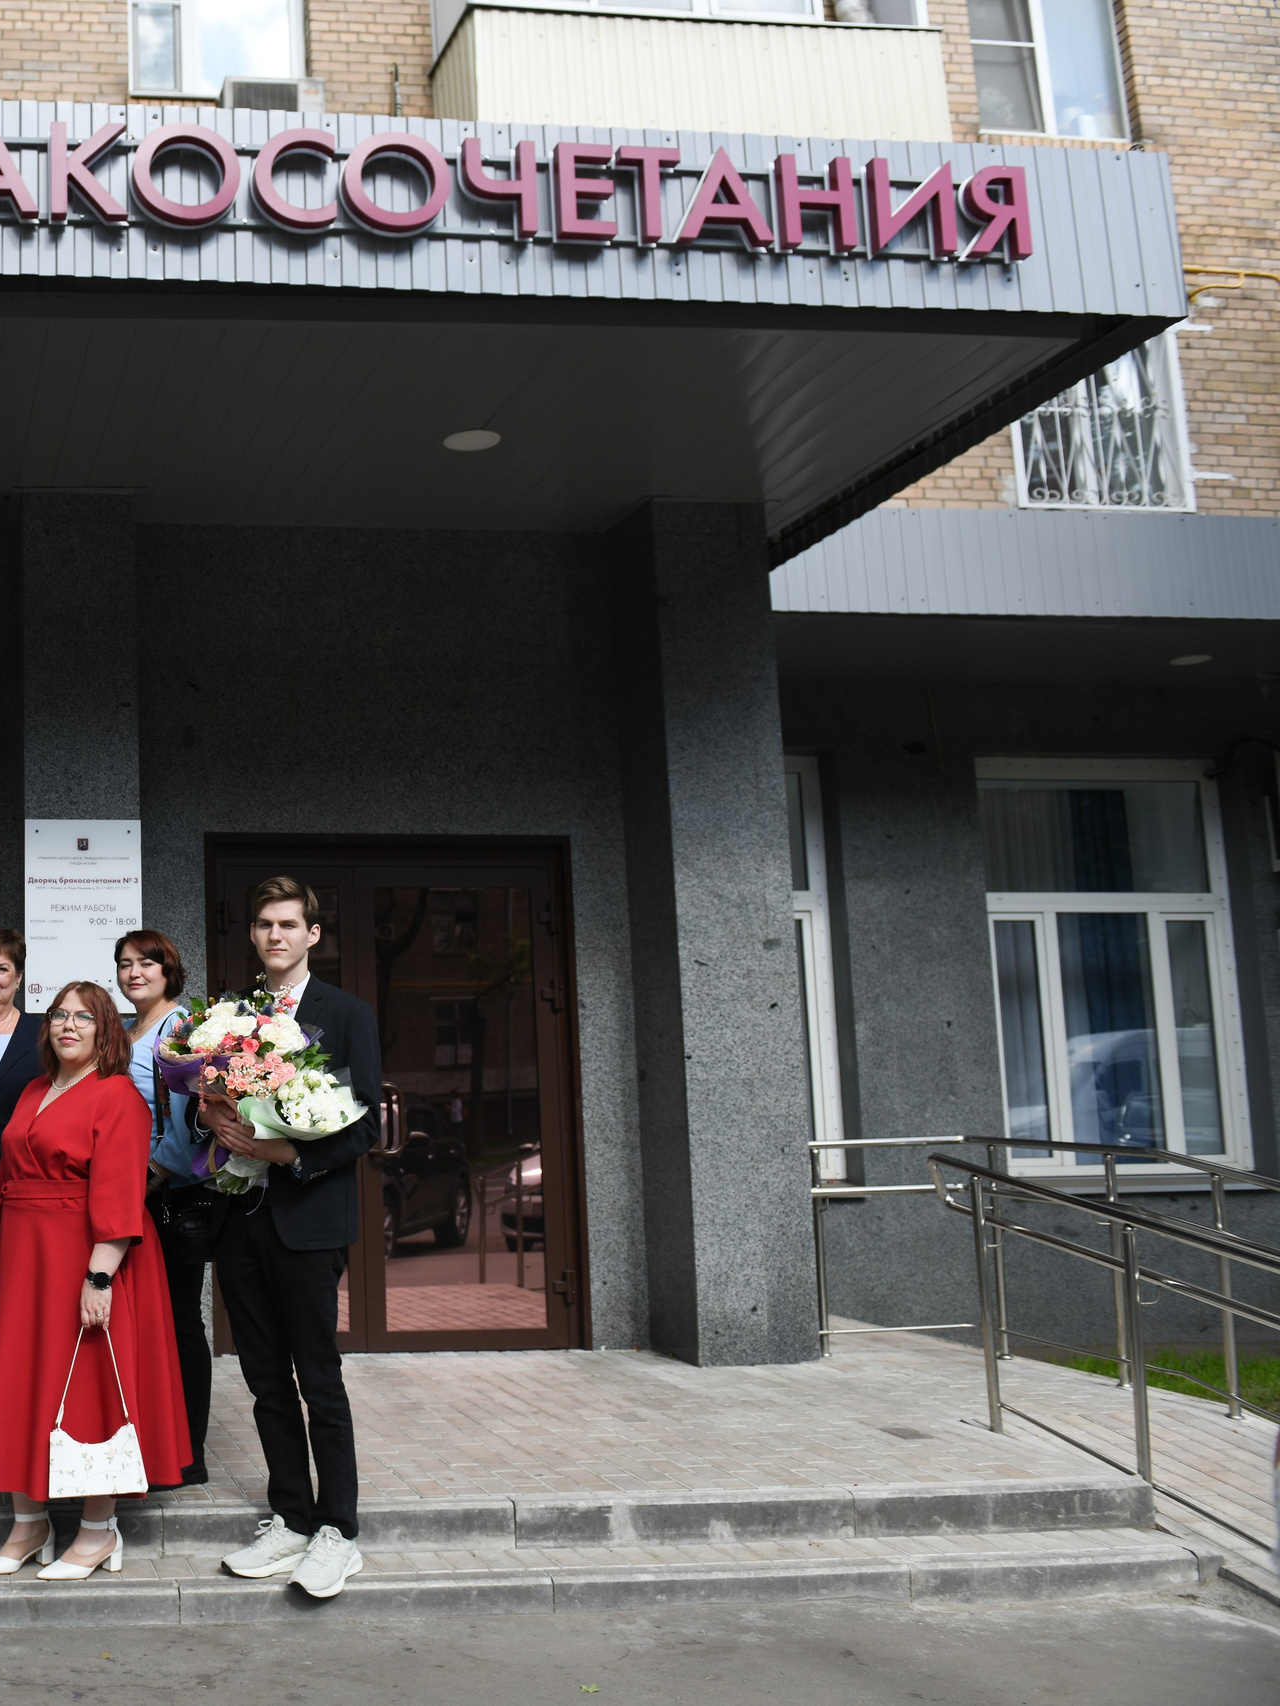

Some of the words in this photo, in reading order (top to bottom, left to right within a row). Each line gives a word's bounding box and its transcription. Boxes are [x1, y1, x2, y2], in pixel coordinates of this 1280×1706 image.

[27, 877, 58, 885] Дворец
[59, 876, 121, 885] бракосочетания
[50, 904, 81, 912] РЕЖИМ
[83, 904, 116, 912] РАБОТЫ
[88, 917, 107, 926] 9:00
[115, 917, 137, 926] 18:00
